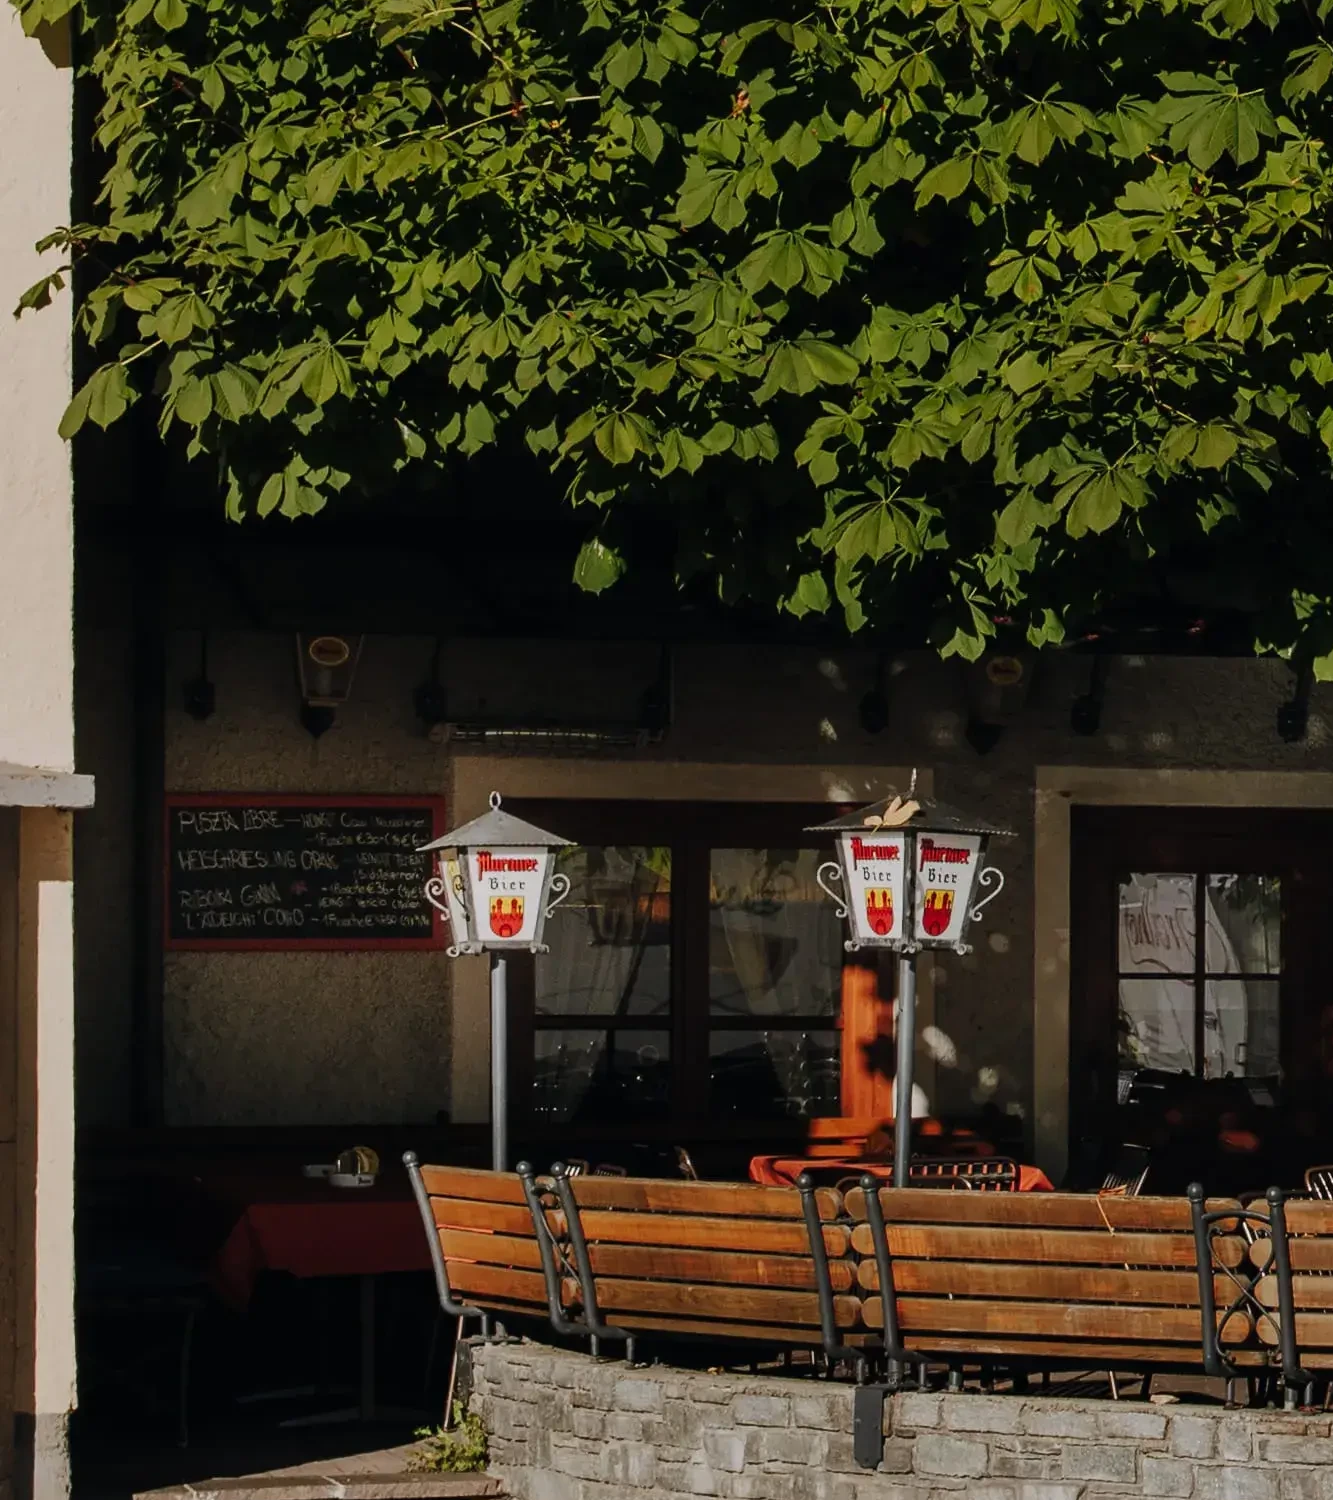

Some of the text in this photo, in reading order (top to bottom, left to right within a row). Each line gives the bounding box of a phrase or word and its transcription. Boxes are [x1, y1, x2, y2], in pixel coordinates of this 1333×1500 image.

[850, 836, 900, 871] Murauer
[919, 838, 970, 872] Murauer
[476, 850, 539, 881] Murauer
[863, 866, 892, 882] Bier
[928, 867, 958, 883] Bier
[488, 876, 527, 890] Bier
